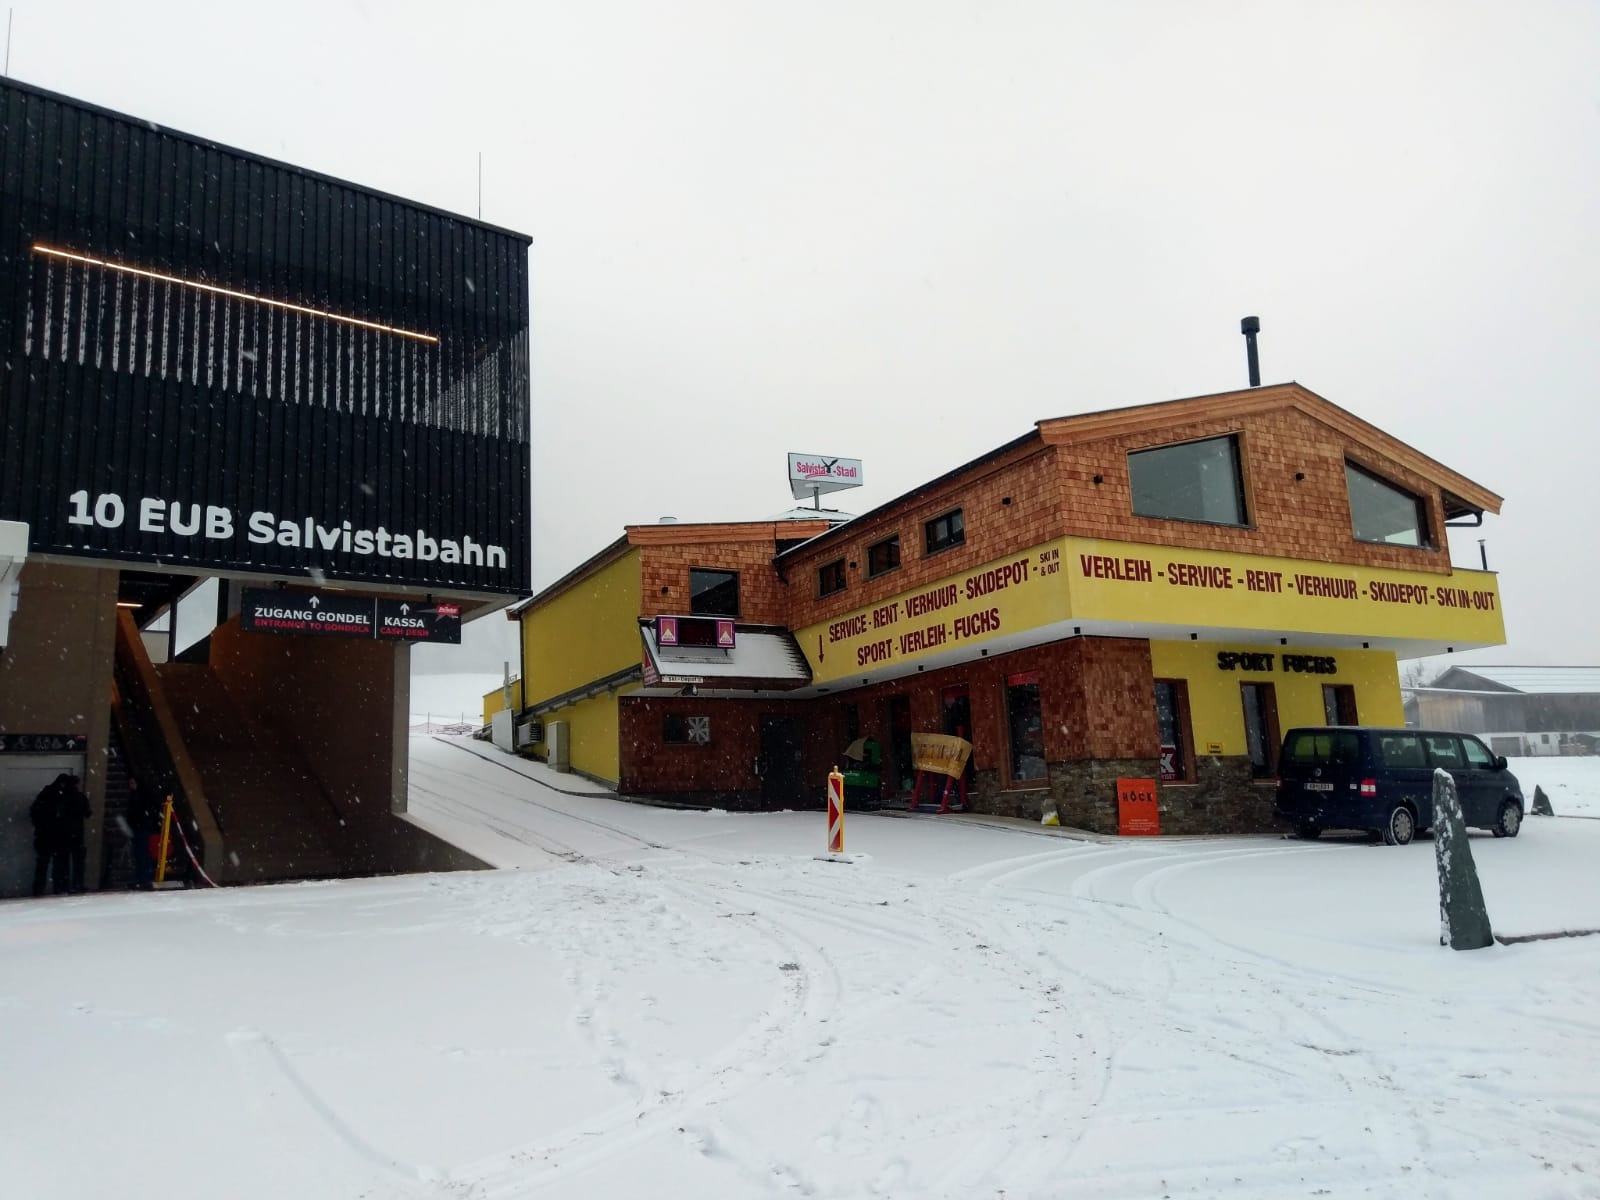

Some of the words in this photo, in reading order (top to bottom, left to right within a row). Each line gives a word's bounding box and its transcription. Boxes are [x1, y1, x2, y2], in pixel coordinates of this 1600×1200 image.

[796, 461, 826, 475] Salvista
[68, 490, 125, 528] 10
[139, 497, 234, 539] EUB
[247, 511, 506, 569] Salvistabahn
[1039, 551, 1051, 564] SKI
[1051, 547, 1060, 561] IN
[1047, 561, 1060, 575] OUT
[1079, 554, 1153, 583] VERLEIH
[1167, 562, 1234, 589] SERVICE
[1245, 569, 1283, 593] RENT
[1294, 574, 1359, 600] VERHUUR
[1369, 580, 1428, 605] SKIDEPOT
[1436, 586, 1456, 608] SKI
[828, 612, 868, 644] SERVICE
[873, 602, 899, 630] RENT
[905, 584, 958, 619] VERHUUR
[966, 558, 1030, 601] SKIDEPOT
[254, 607, 313, 621] ZUGANG
[316, 611, 371, 625] GONDEL
[384, 616, 425, 628] KASSA
[254, 618, 306, 630] ENTRANCE
[310, 622, 322, 630] TO
[324, 623, 370, 633] GONDOLA
[856, 639, 893, 667] SPORT
[899, 623, 947, 655] VERLEIH
[953, 608, 1001, 641] FUCHS
[1217, 651, 1275, 672] SPORT
[1281, 654, 1338, 675] FUCHS
